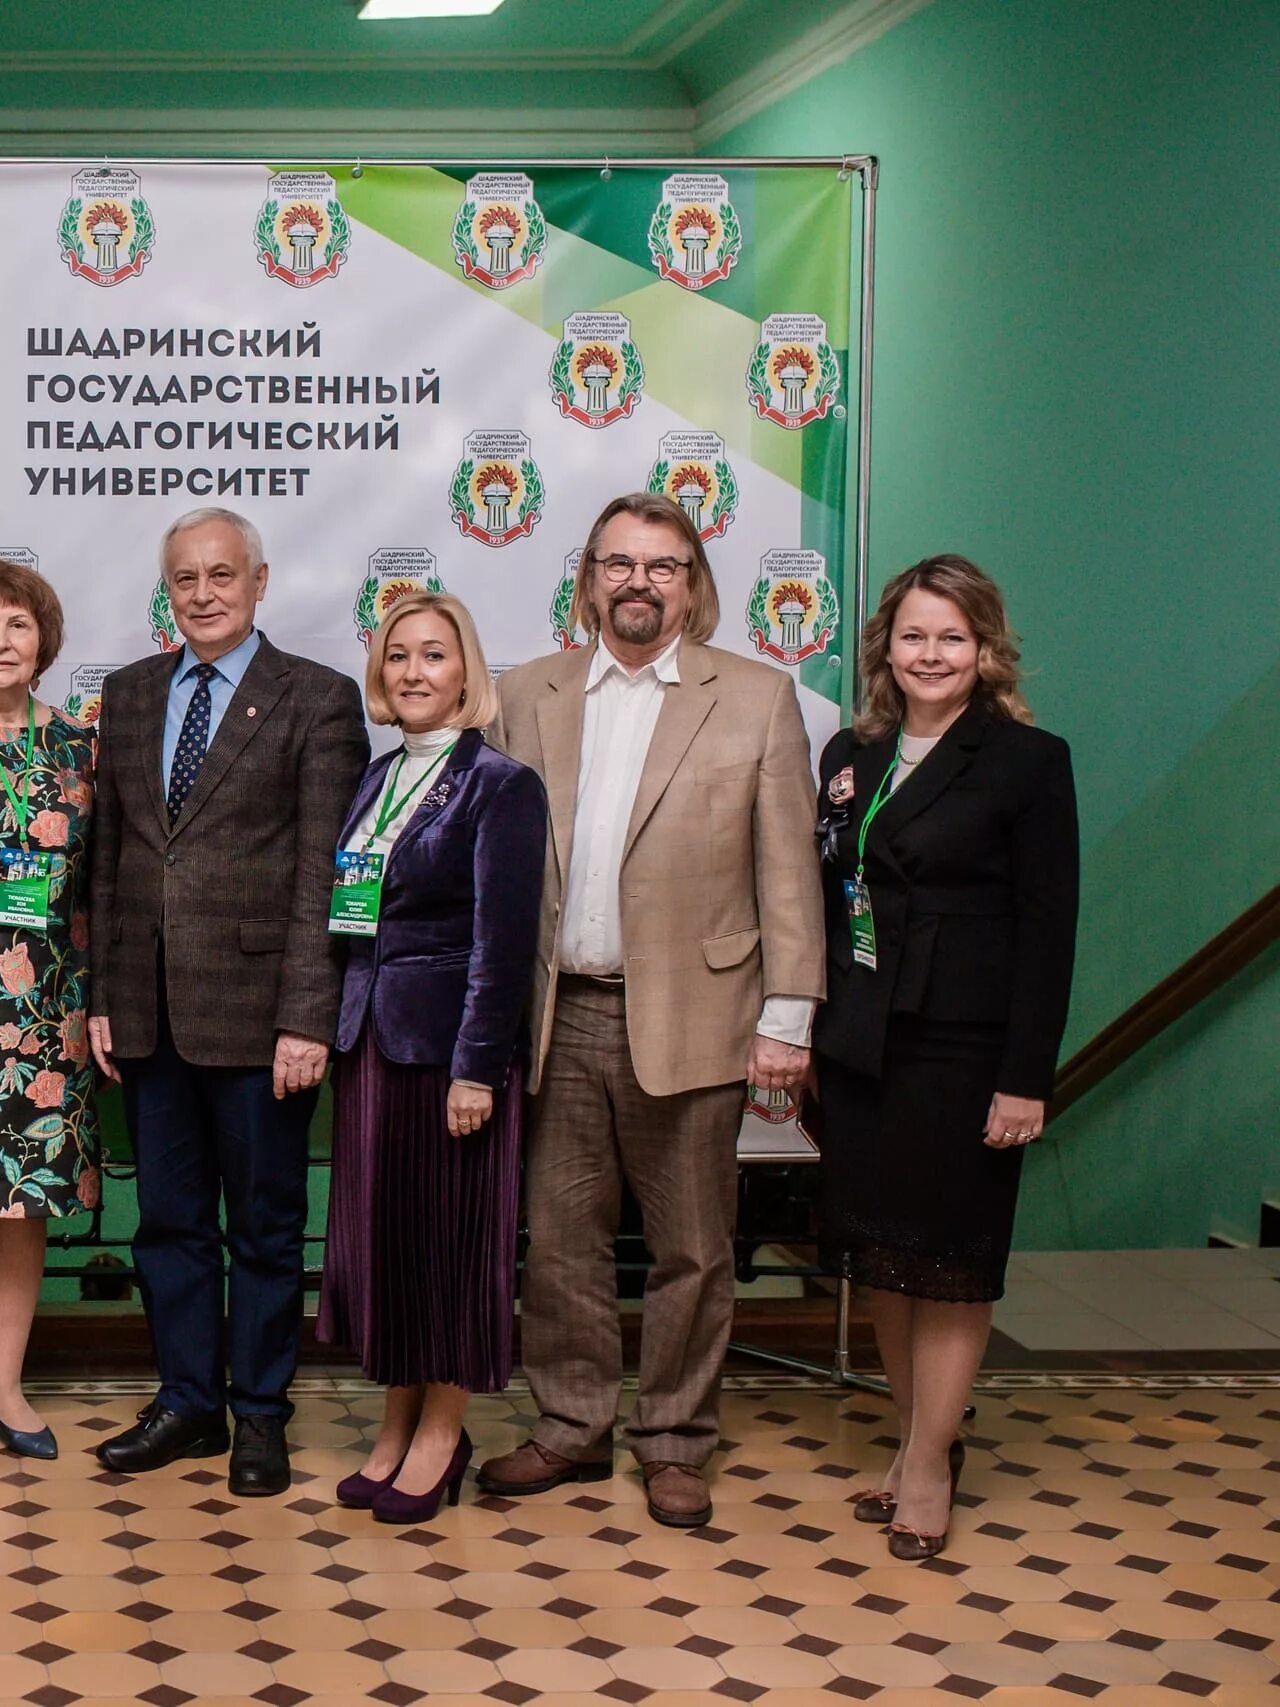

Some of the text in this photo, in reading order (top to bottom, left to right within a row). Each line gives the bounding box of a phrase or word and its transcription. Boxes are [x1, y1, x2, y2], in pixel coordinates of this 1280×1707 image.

[99, 275, 115, 283] 1939
[28, 321, 320, 359] ШАДРИНСКИЙ
[27, 368, 440, 406] ГОСУДАРСТВЕННЫЙ
[589, 417, 605, 425] 1939
[27, 414, 399, 452] ПЕДАГОГИЧЕСКИЙ
[24, 468, 310, 496] УНИВЕРСИТЕТ
[5, 915, 36, 923] УЧАСТНИК
[770, 1112, 785, 1121] 1939
